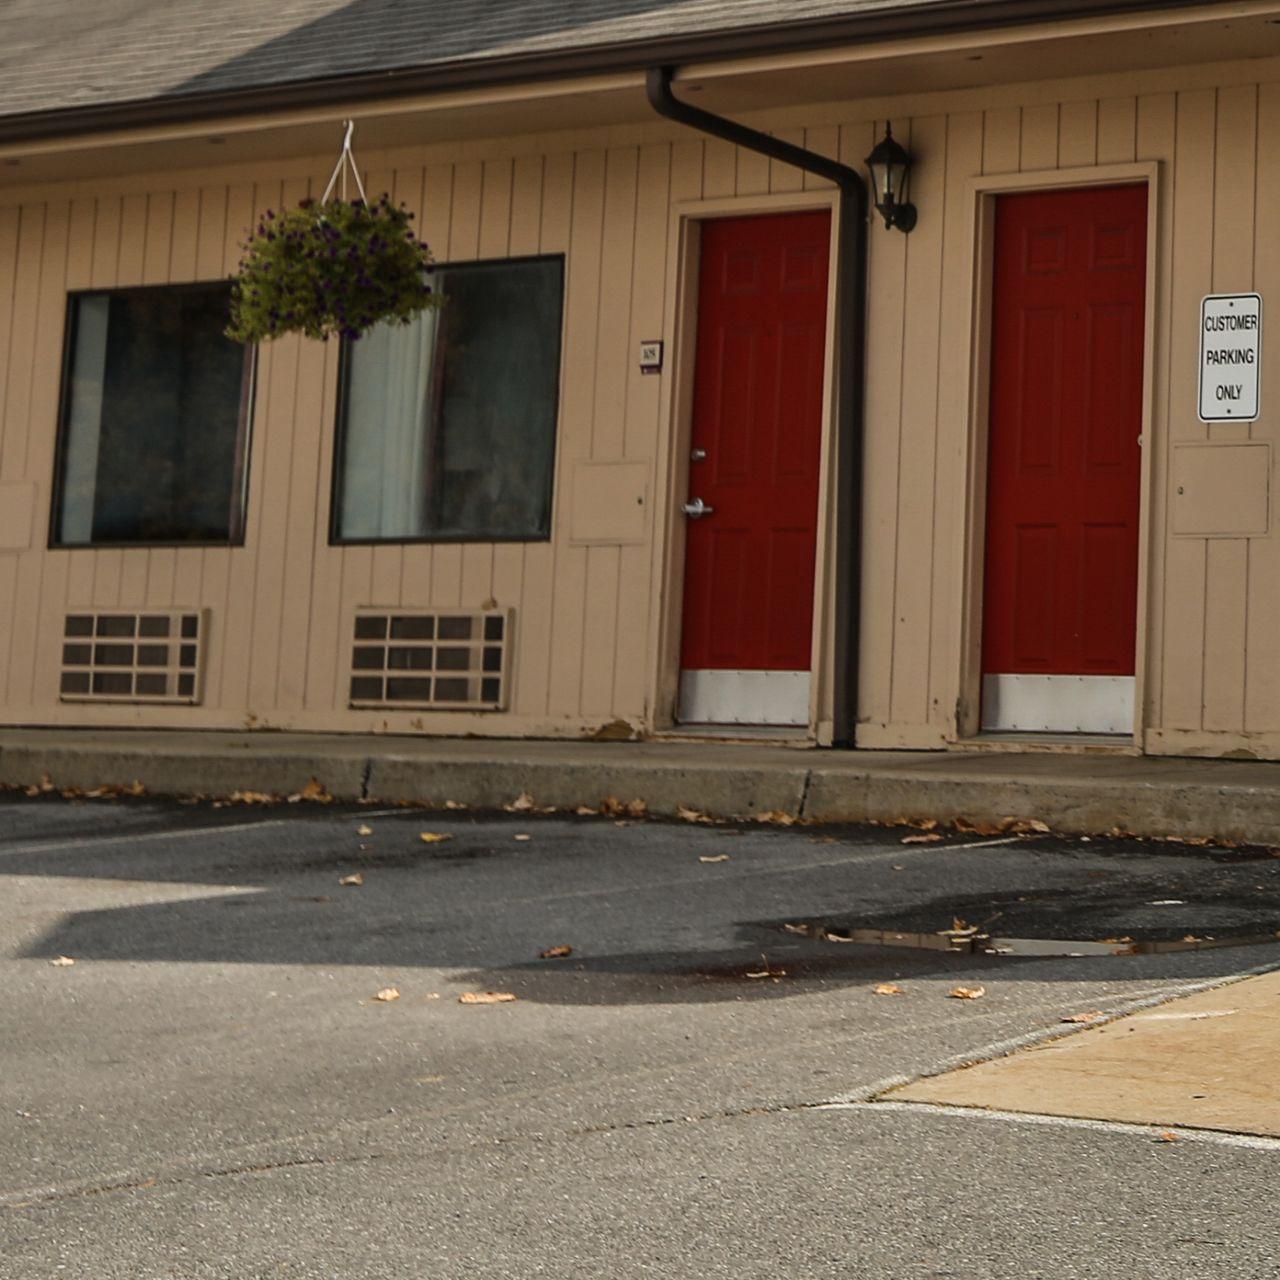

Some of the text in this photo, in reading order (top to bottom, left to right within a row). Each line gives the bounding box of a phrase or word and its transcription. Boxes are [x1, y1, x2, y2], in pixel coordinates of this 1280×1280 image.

[1204, 314, 1258, 332] CUSTOMER
[1206, 347, 1255, 365] PARKING
[1215, 384, 1243, 401] ONLY
